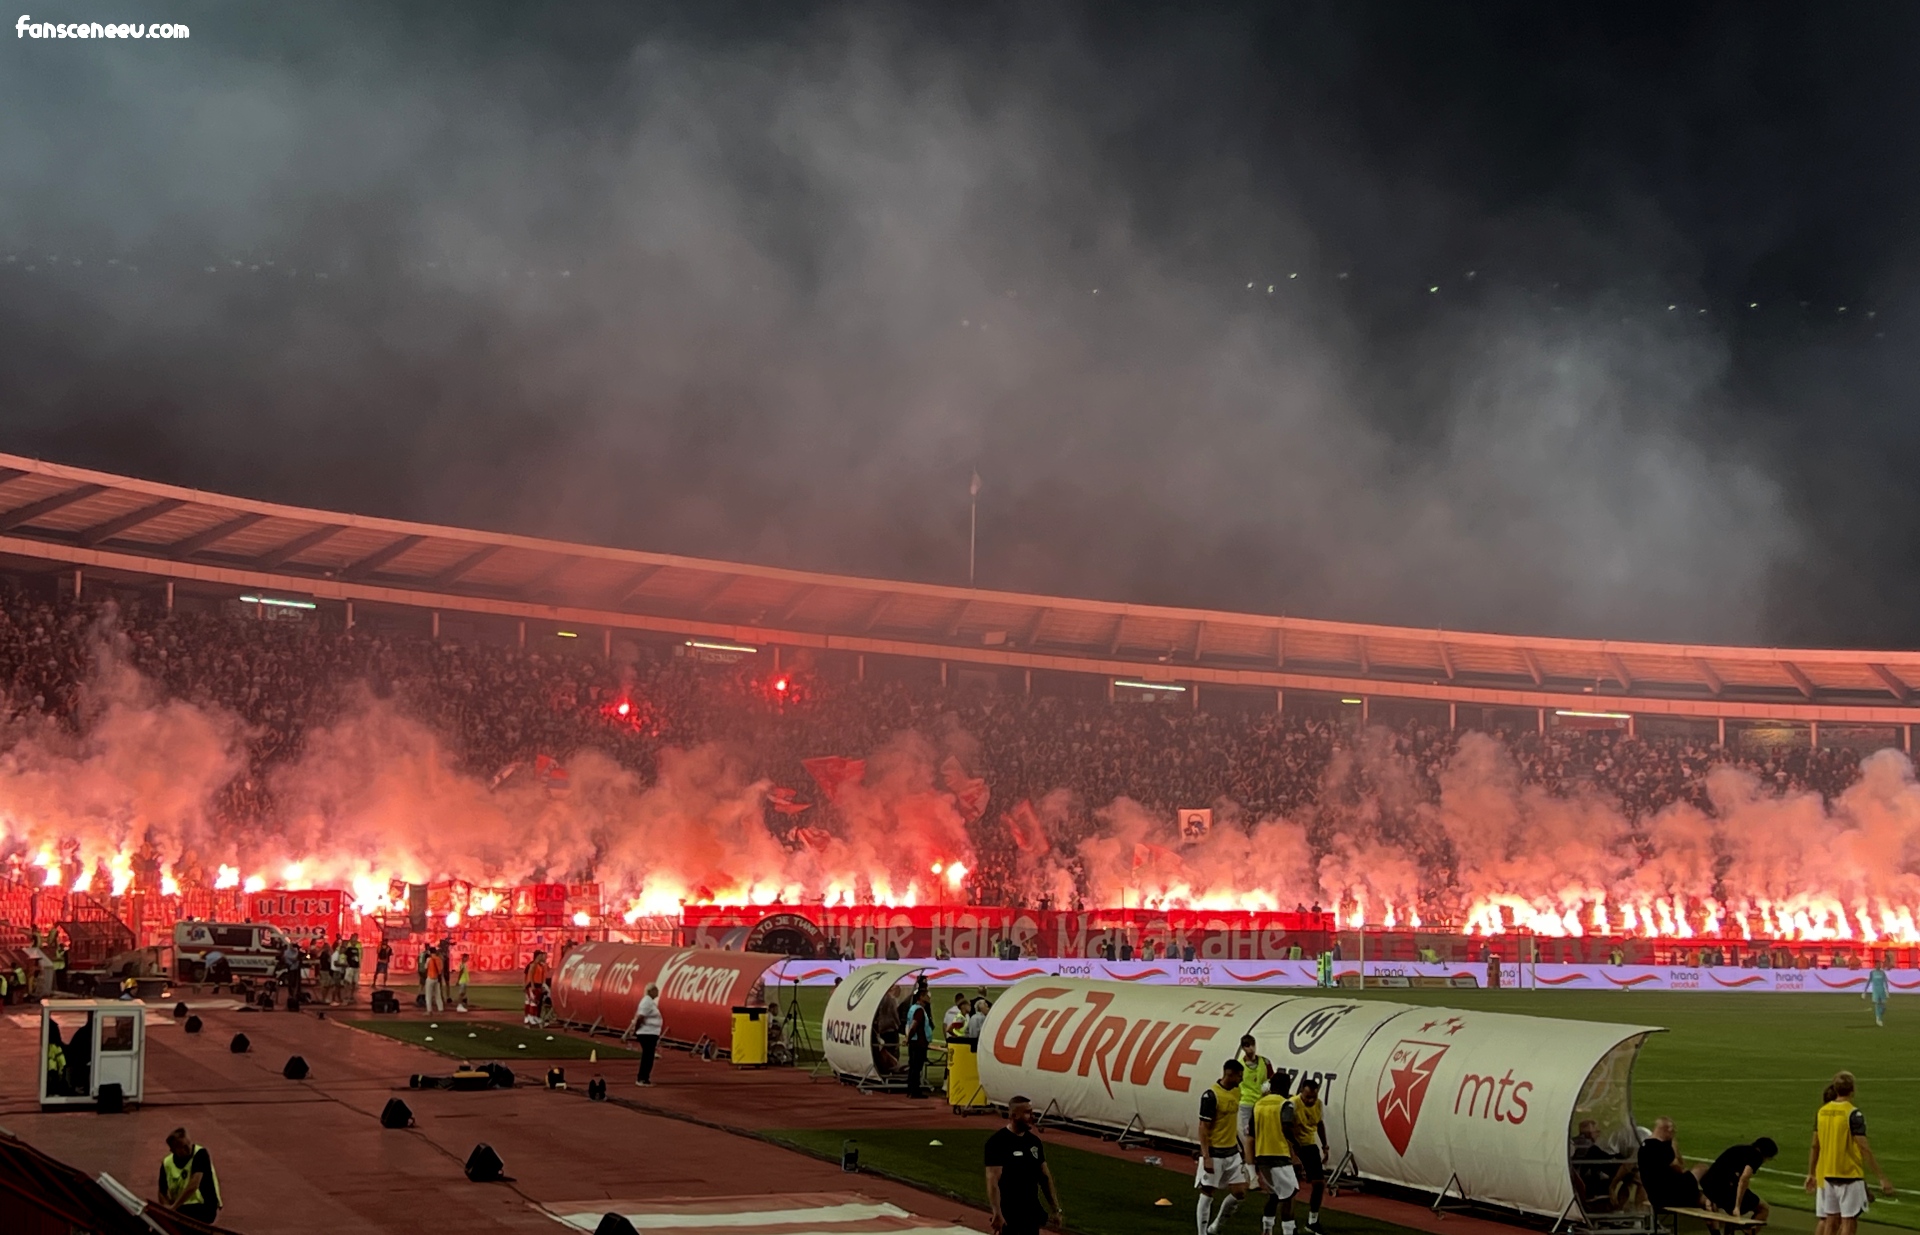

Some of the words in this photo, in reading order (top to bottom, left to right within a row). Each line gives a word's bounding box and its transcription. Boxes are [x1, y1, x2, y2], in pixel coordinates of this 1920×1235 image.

[256, 893, 335, 917] ultra
[602, 957, 640, 995] mts
[1058, 963, 1091, 974] hrana
[1178, 964, 1210, 975] hrana
[1670, 970, 1699, 980] hrana
[1775, 971, 1804, 982] hrana
[667, 963, 741, 1007] macron
[1182, 999, 1243, 1018] FUEL
[825, 1018, 868, 1048] MOZZART
[1392, 1049, 1413, 1064] ФК
[1453, 1068, 1535, 1126] mts
